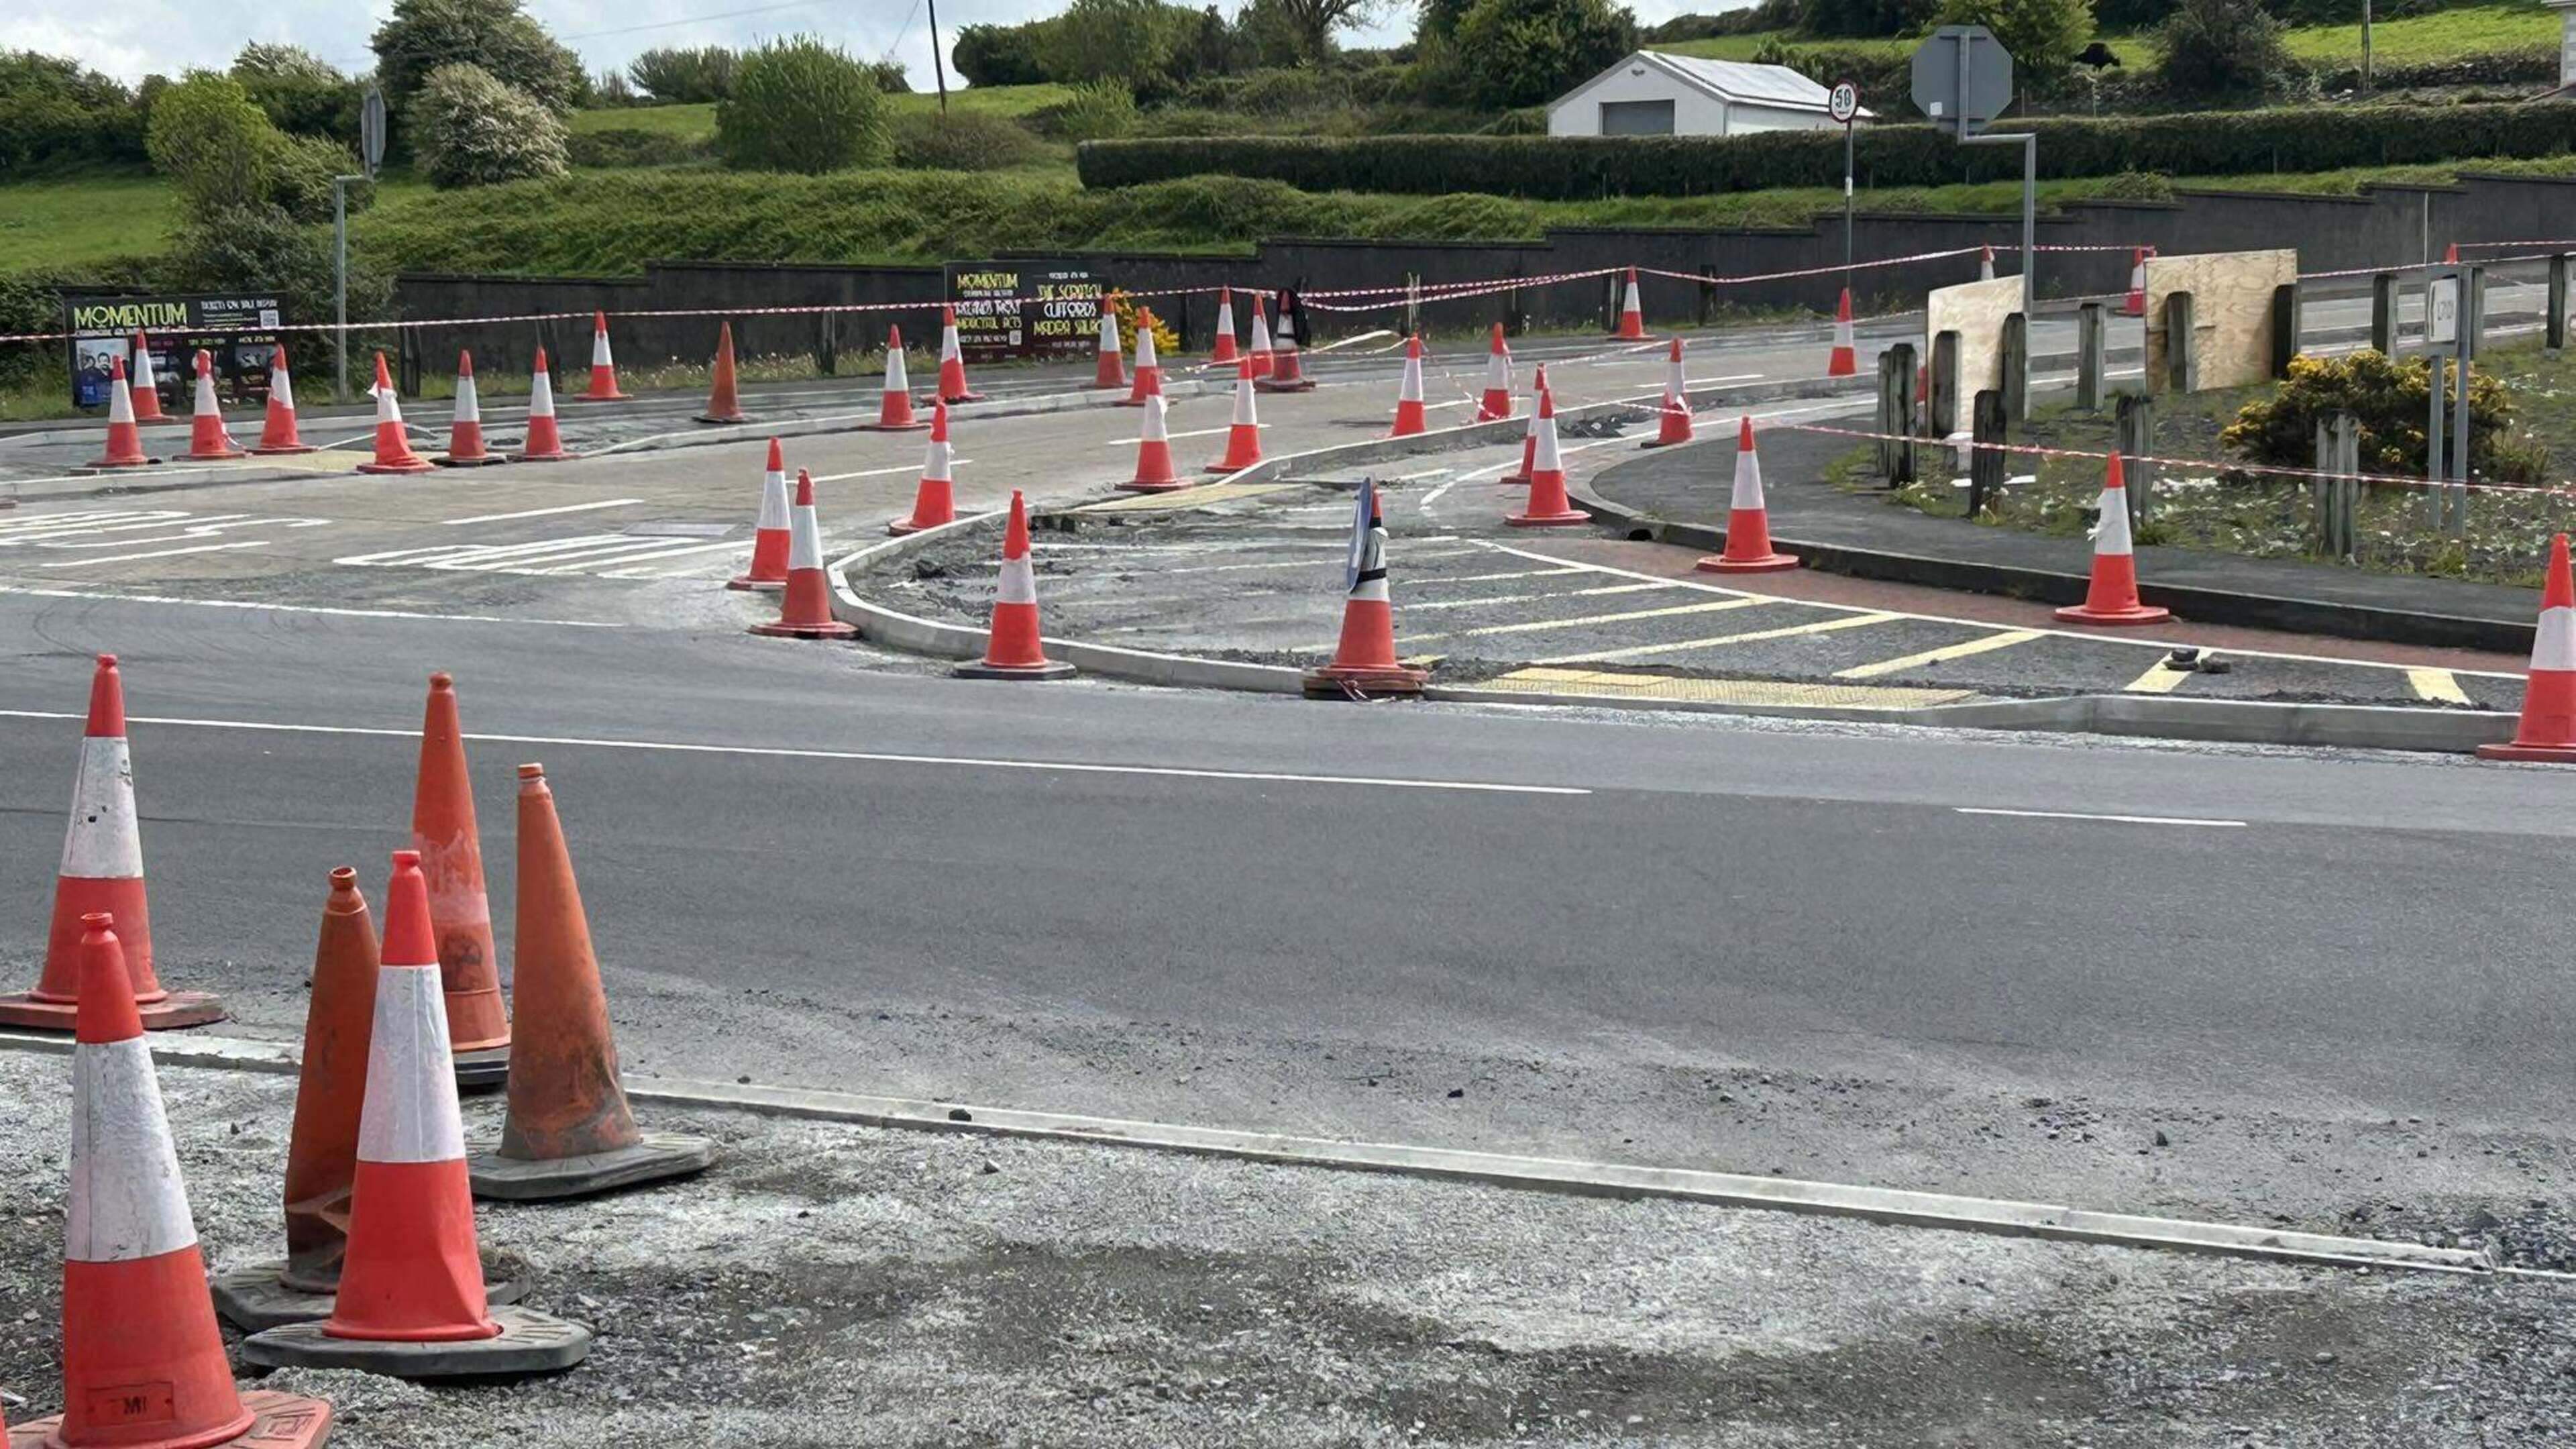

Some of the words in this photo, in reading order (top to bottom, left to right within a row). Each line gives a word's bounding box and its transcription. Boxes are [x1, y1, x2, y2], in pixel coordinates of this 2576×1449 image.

[1835, 89, 1851, 108] 50
[957, 273, 1018, 290] MOMENTUM
[73, 303, 186, 328] MOMENTUM
